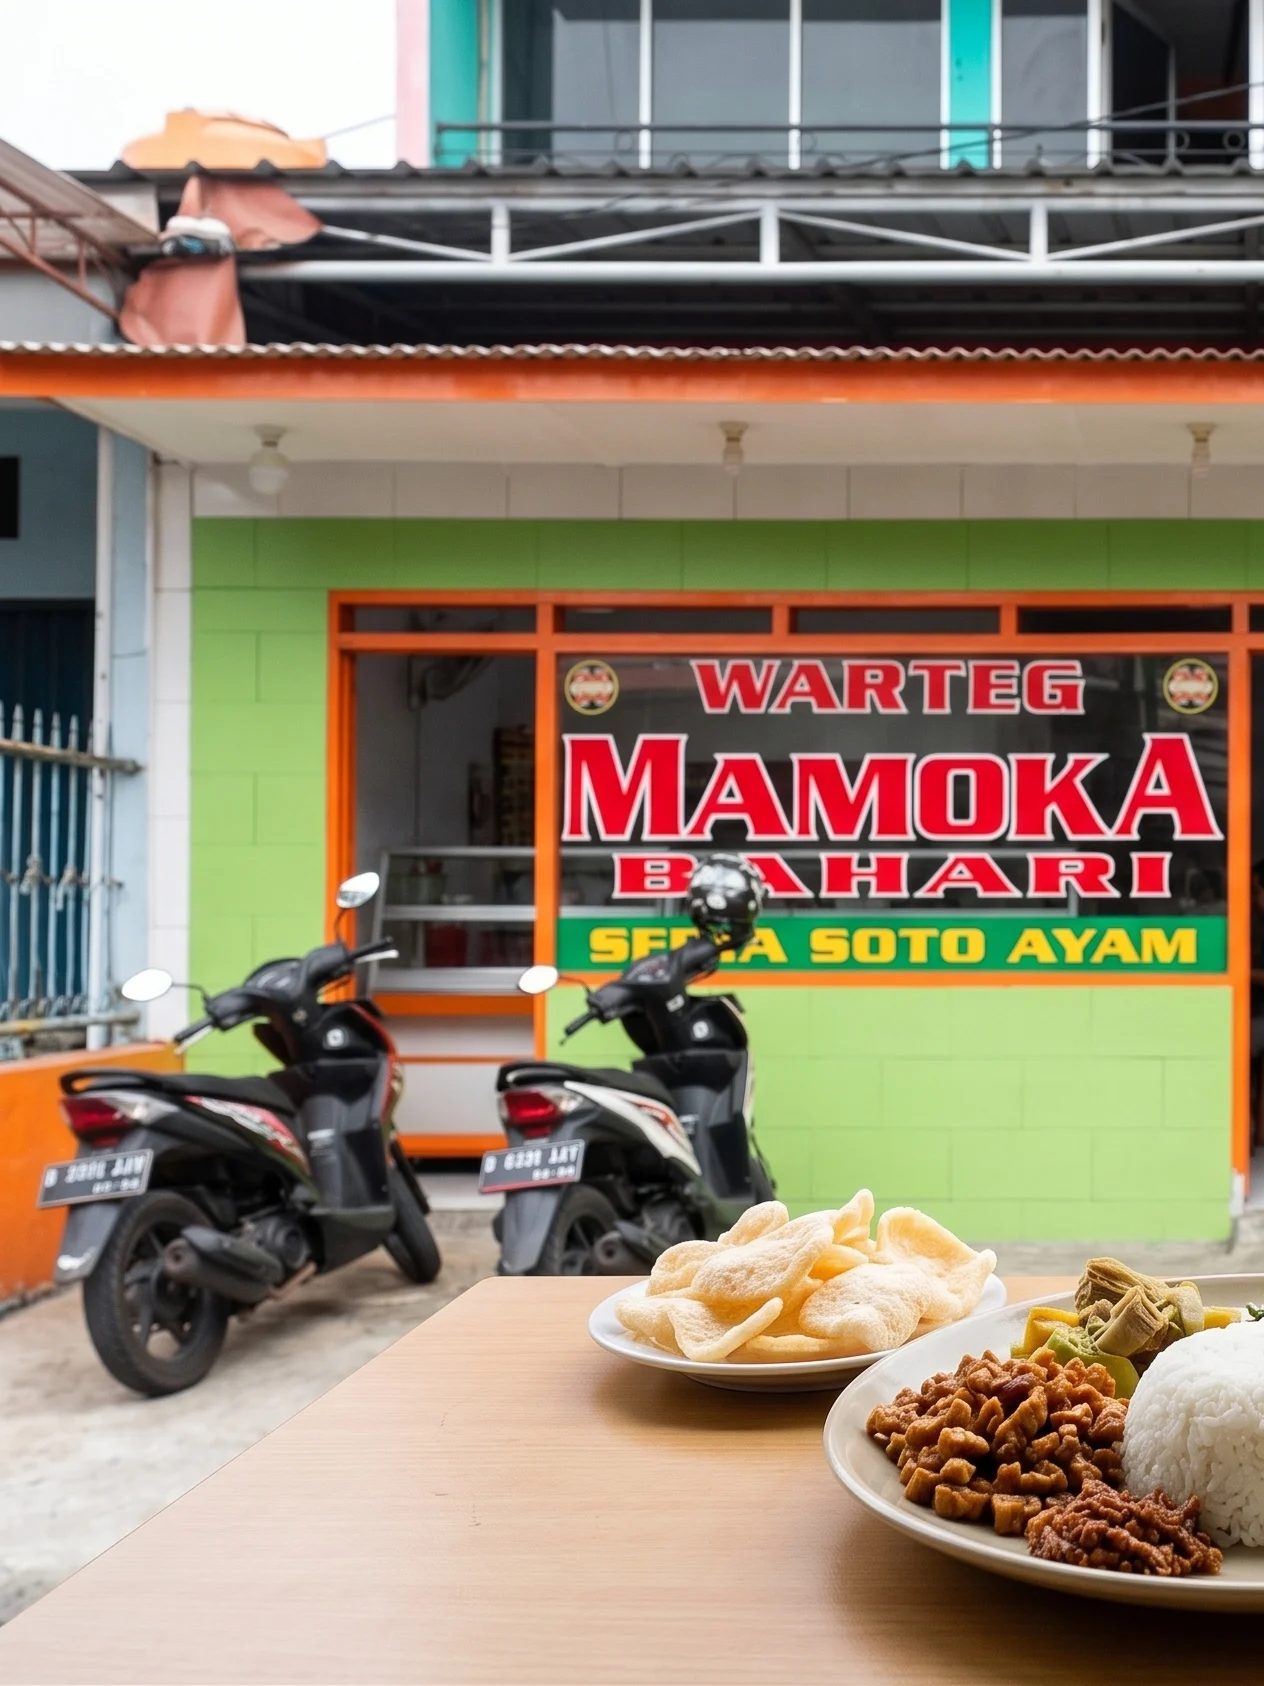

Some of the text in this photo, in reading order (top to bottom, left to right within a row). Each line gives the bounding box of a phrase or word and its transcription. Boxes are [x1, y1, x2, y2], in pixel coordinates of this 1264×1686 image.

[690, 659, 1086, 715] WARTEG
[561, 732, 1225, 841] MAMOKA
[810, 927, 985, 963] SOTO
[1007, 927, 1197, 964] AYAM
